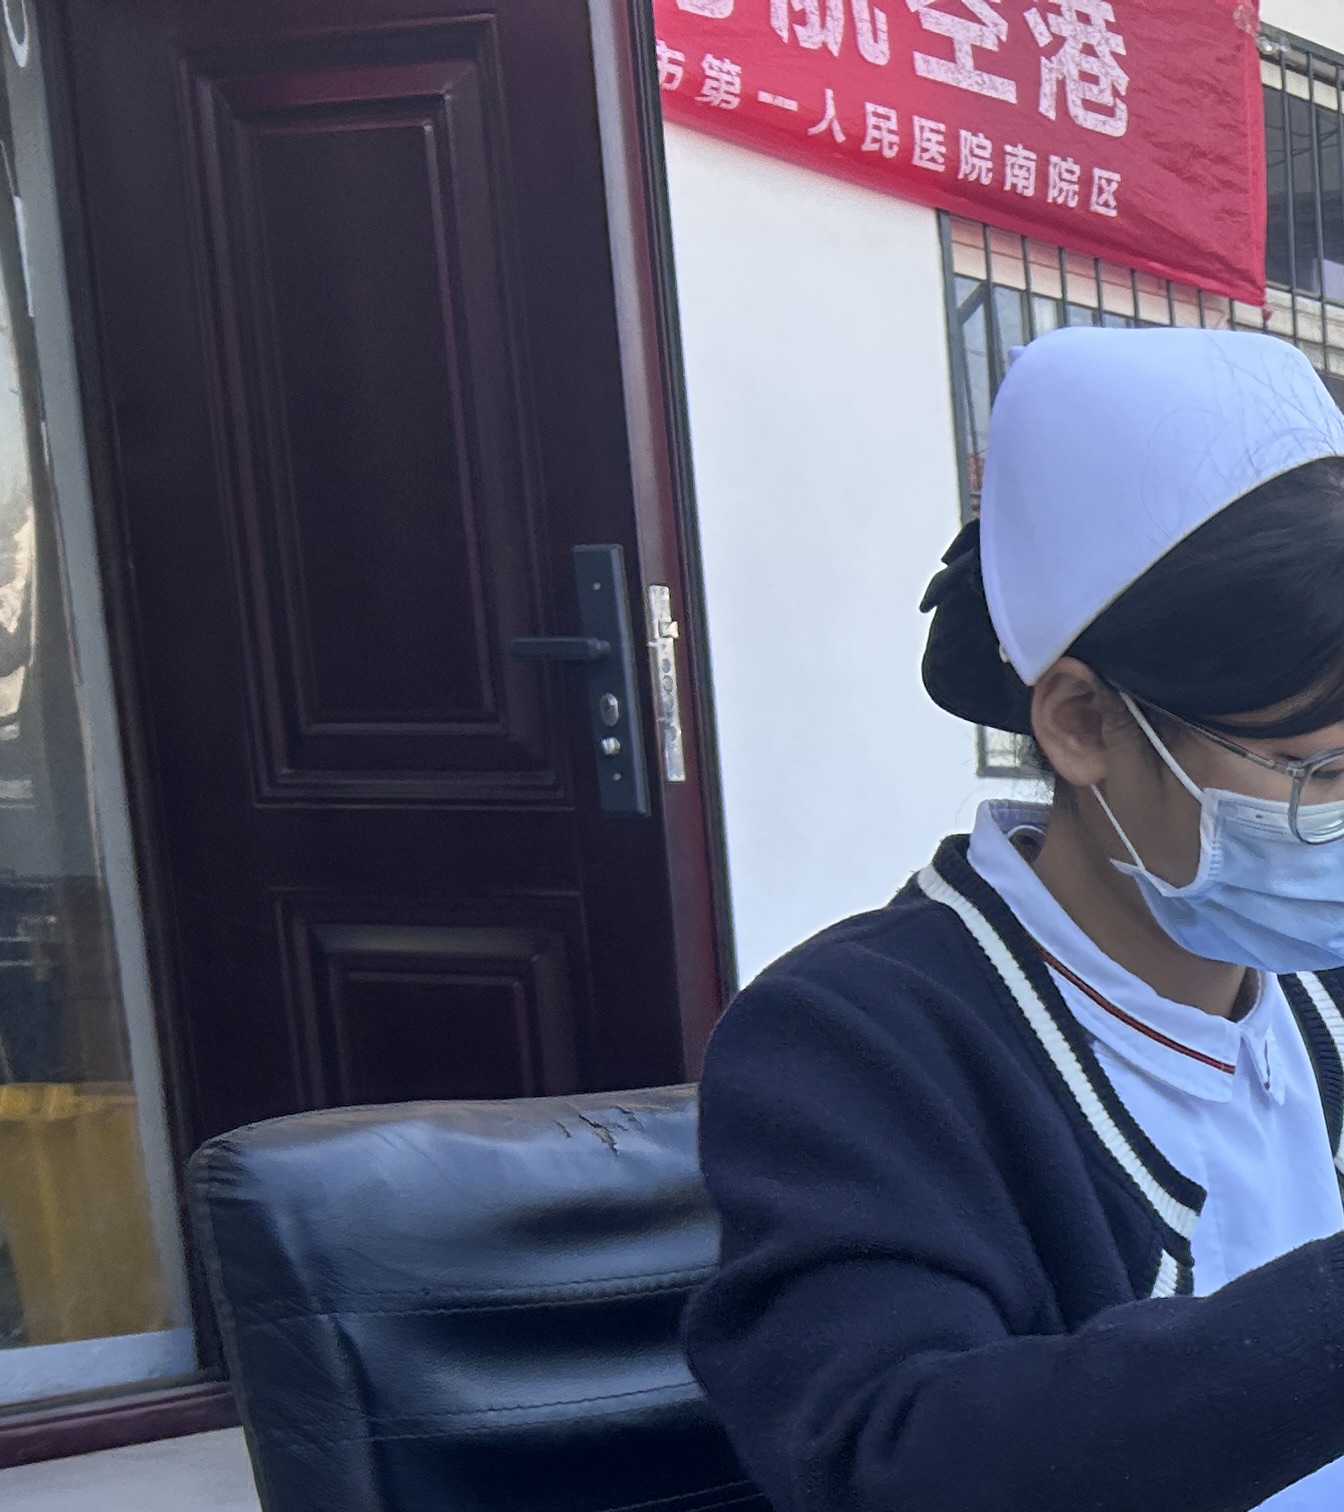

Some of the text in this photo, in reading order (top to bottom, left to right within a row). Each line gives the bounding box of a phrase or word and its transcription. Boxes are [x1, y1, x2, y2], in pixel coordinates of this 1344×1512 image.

[656, 40, 1121, 218] 市第一人民医院南院区
